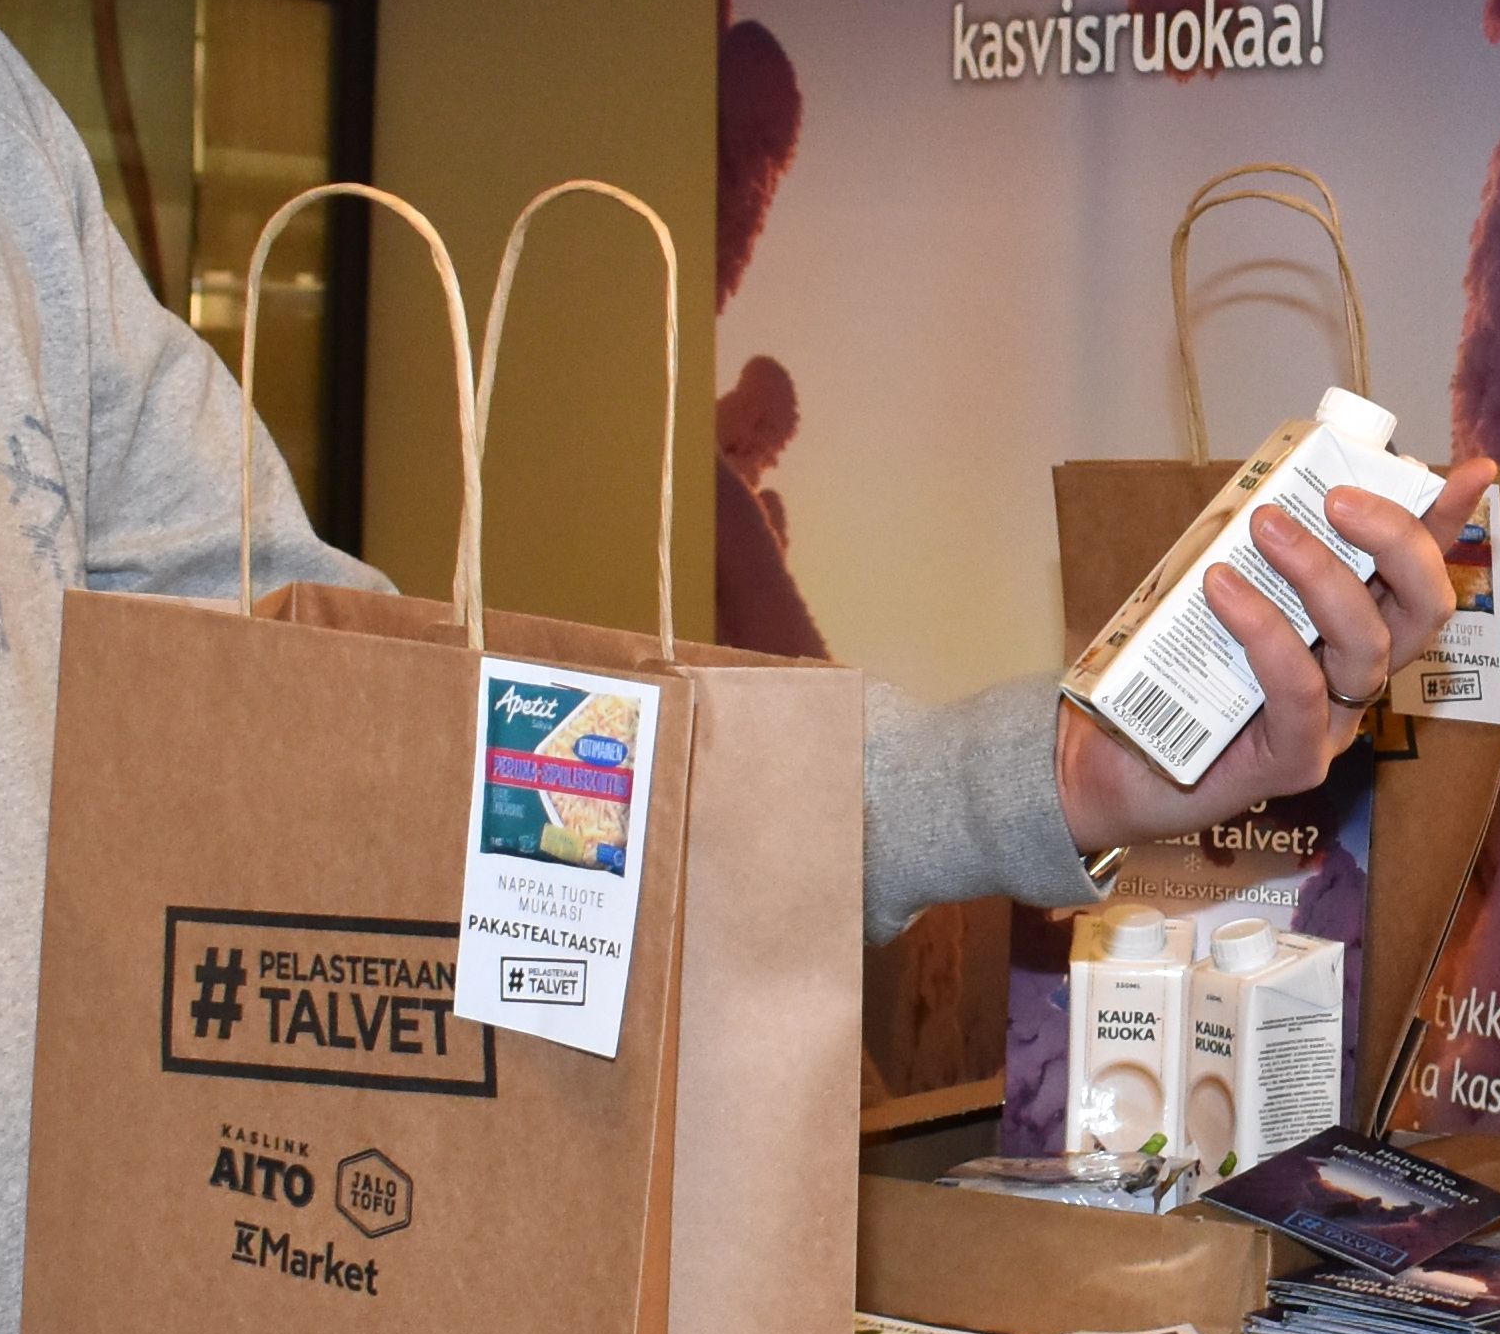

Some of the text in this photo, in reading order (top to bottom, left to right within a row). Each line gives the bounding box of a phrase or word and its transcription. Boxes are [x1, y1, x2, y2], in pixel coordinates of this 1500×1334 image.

[1434, 633, 1471, 646] UKAASI
[1455, 623, 1483, 637] TUOTE
[1419, 649, 1500, 668] ASTEALTAASTA!
[1440, 683, 1475, 696] TALVET
[494, 685, 559, 723] Apetit
[1211, 821, 1319, 855] talvet?
[498, 875, 604, 908] NAPPAA TUOTE
[1162, 878, 1300, 907] kasvisruokaa!
[519, 897, 582, 922] MUKAASI
[468, 914, 621, 958] PAKASTEALTAASTA!
[260, 950, 457, 992] PELASTETAAN
[529, 978, 578, 995] TALVET
[260, 987, 454, 1055] TALVET
[1098, 1009, 1161, 1026] KAURA-
[1097, 1026, 1156, 1042] RUOKA
[1195, 1037, 1232, 1058] RUOKA
[221, 1124, 309, 1157] KASLINK
[209, 1146, 315, 1207] AITO
[1333, 1143, 1480, 1205] pelastaa talvet?
[1375, 1148, 1457, 1187] Haluatko
[352, 1171, 397, 1197] JALO
[351, 1190, 395, 1216] TOFU
